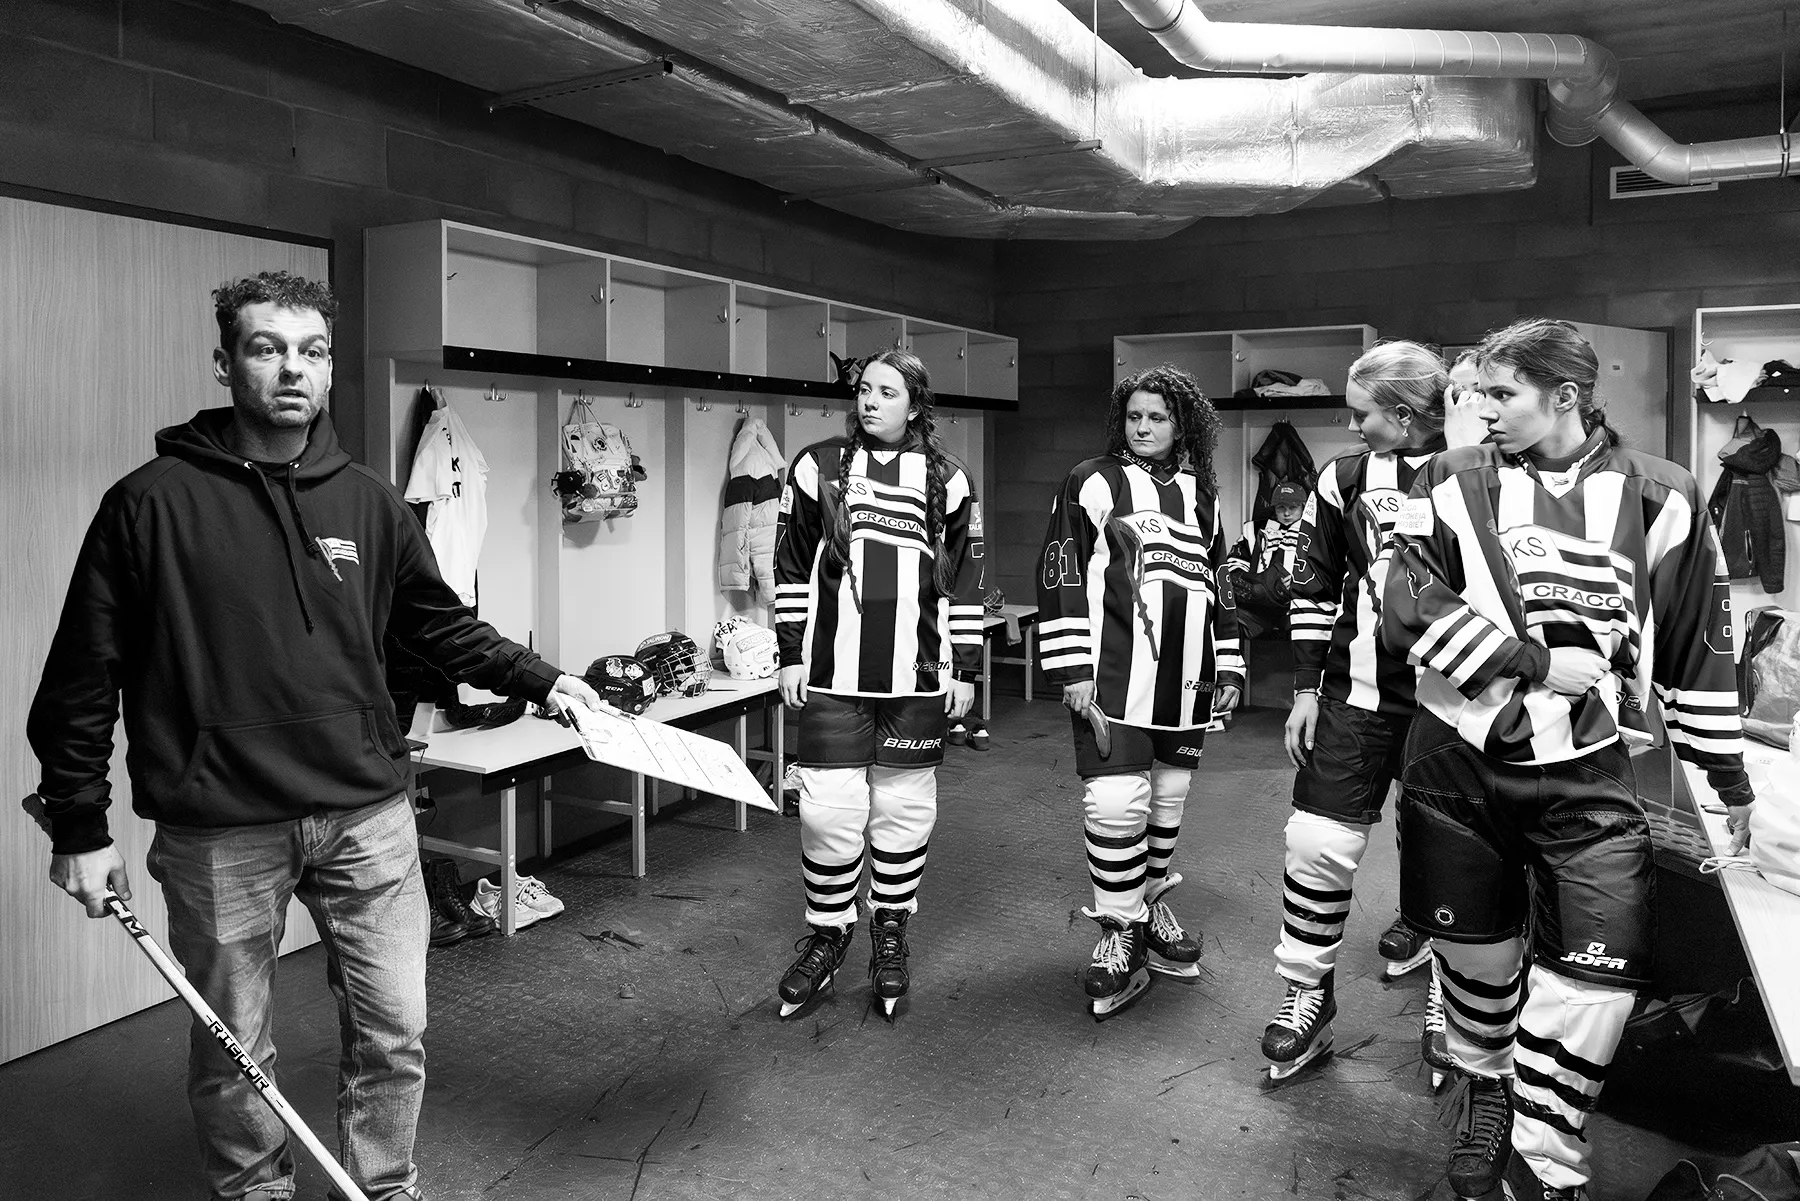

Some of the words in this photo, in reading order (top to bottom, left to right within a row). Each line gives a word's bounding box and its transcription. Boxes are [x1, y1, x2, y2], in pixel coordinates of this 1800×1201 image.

[1371, 497, 1399, 512] KS
[968, 523, 983, 531] TAU
[1135, 518, 1162, 534] KS
[1509, 536, 1547, 558] KS
[1042, 537, 1082, 590] 81
[1151, 551, 1211, 579] CRACOVA
[1533, 584, 1623, 609] CRACO
[883, 737, 942, 750] BAUER
[1176, 745, 1203, 757] BAU
[104, 883, 150, 938] CM
[1560, 951, 1628, 970] JOFA
